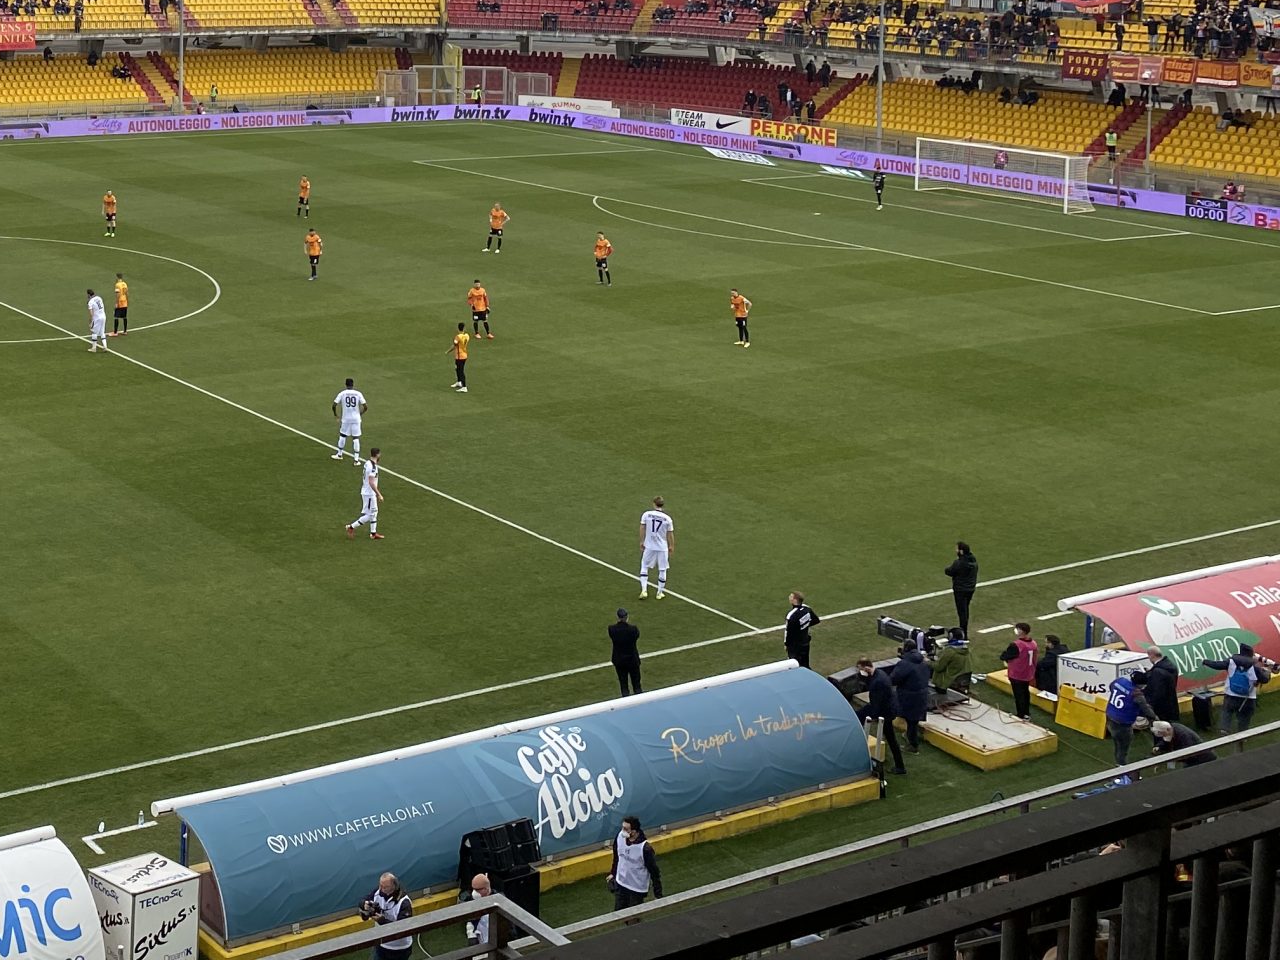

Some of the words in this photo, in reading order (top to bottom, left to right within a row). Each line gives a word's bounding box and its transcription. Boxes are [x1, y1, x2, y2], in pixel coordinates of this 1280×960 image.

[1068, 56, 1104, 67] PONTE
[1069, 67, 1099, 77] 1998
[391, 106, 439, 121] bwin.tv
[454, 105, 511, 120] bwin.tv
[529, 108, 576, 127] bwin.tv
[679, 110, 703, 120] TEAM
[128, 118, 211, 133] AUTONOLEGGIO
[221, 115, 274, 128] NOLEGGIO
[683, 118, 706, 128] WEAR
[611, 122, 675, 139] AUTONOLEGGIO
[683, 131, 728, 147] NOLEGGIO
[751, 120, 837, 146] PETRONE
[972, 170, 1033, 191] NOLEGGIO
[1189, 207, 1224, 221] 00:00
[345, 396, 356, 407] 99
[652, 519, 662, 532] 17
[1169, 636, 1241, 676] MAURO
[1110, 689, 1126, 709] 16
[736, 714, 757, 740] la
[534, 767, 624, 847] Aloia
[288, 801, 435, 848] WWW.CAFFEALOIA.IT
